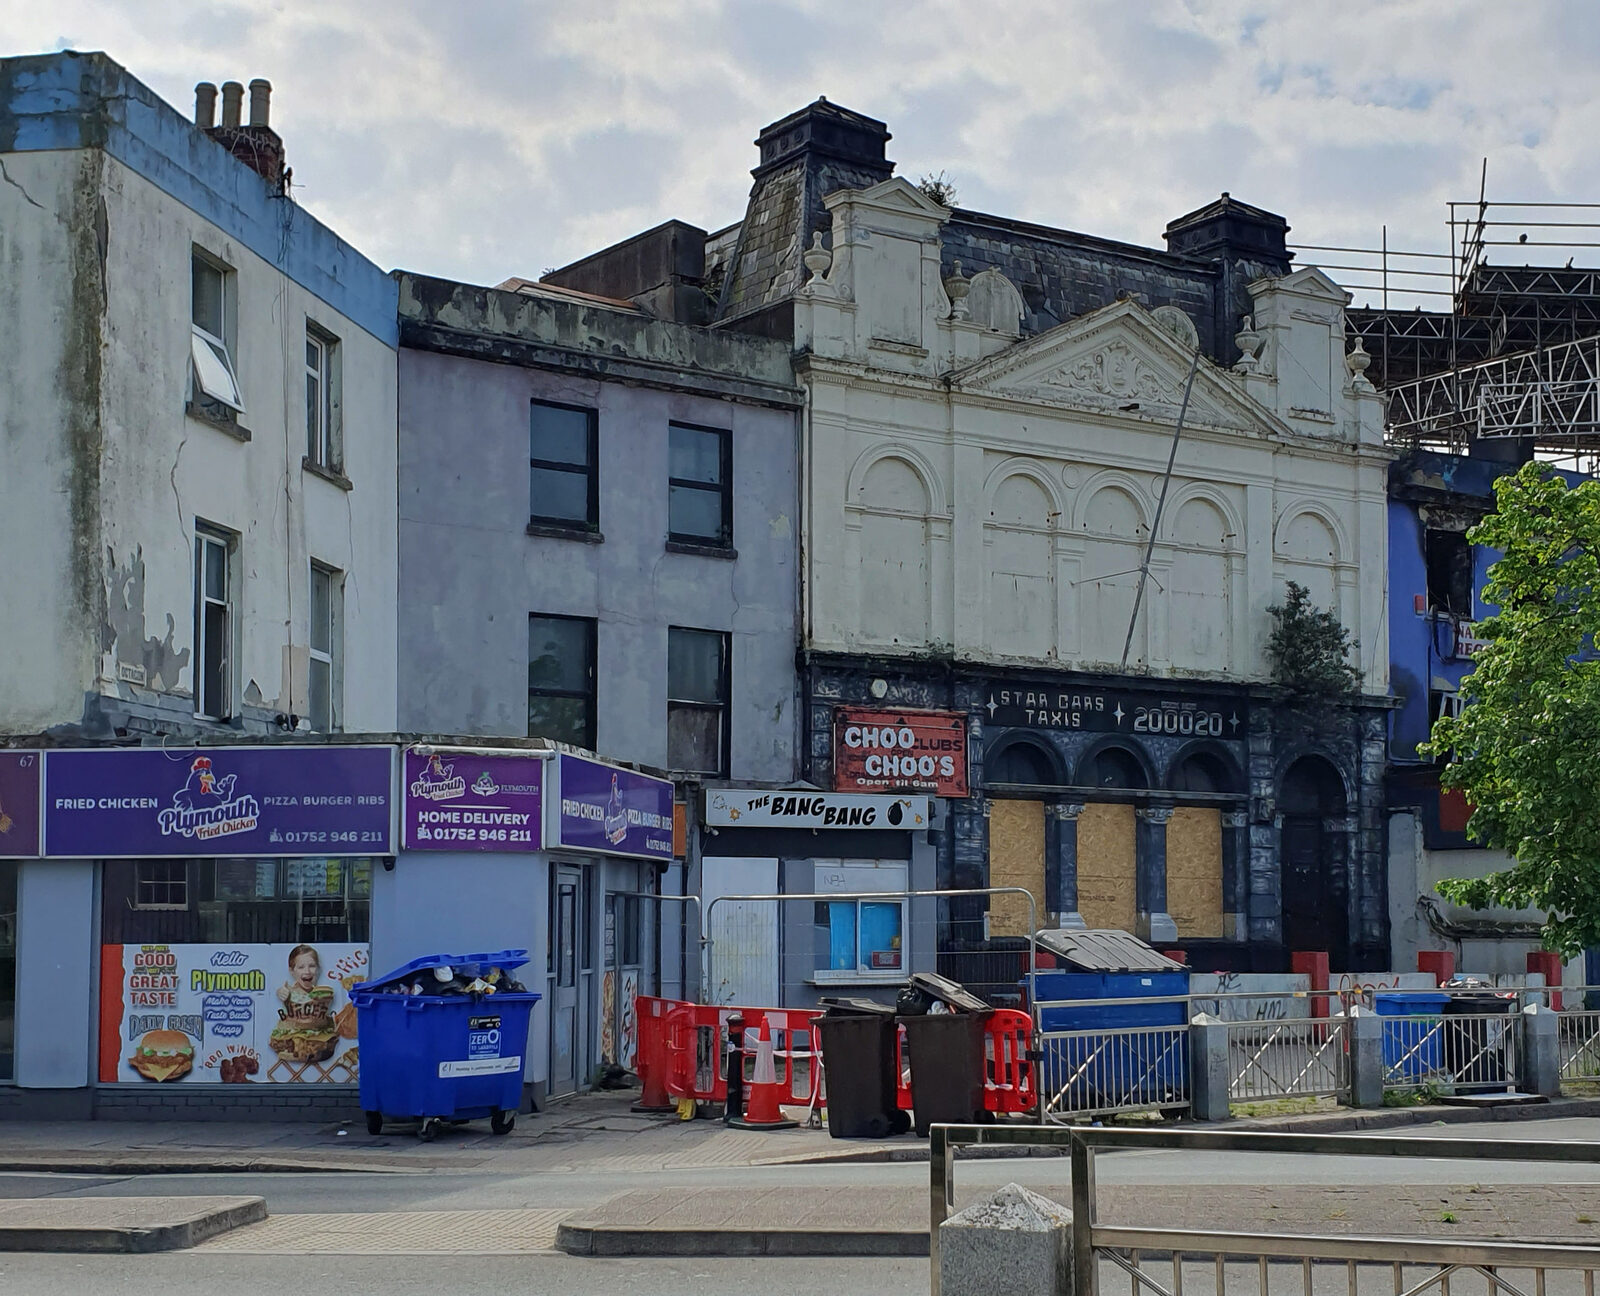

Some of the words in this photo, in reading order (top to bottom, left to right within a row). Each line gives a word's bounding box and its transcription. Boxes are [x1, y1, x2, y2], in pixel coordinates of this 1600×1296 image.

[1000, 690, 1049, 708] STAR
[1058, 694, 1104, 712] CARS
[1025, 709, 1081, 727] TAXIS
[1133, 706, 1223, 737] 200020
[844, 726, 915, 749] CHOO
[20, 755, 34, 768] 67
[865, 754, 955, 777] CHOO'S
[412, 777, 466, 798] Plymouth
[856, 777, 889, 787] Open
[912, 779, 939, 788] 6am
[55, 798, 96, 810] FRIED
[98, 797, 159, 809] CHICKEN
[263, 796, 298, 806] PIZZA
[303, 796, 352, 806] BURGER
[357, 795, 385, 805] RIBS
[158, 796, 259, 836] Plymouth
[418, 811, 460, 823] HOME
[463, 812, 530, 825] DELIVERY
[562, 799, 580, 817] FRIED
[580, 803, 605, 821] CHICKEN
[747, 794, 770, 812] THE
[770, 796, 826, 816] BANG
[823, 806, 877, 826] BANG
[198, 824, 220, 838] Fried
[222, 818, 256, 834] Chicken
[433, 828, 476, 840] 01752
[478, 829, 507, 841] 946
[509, 830, 532, 842] 211
[285, 831, 327, 843] 01752
[329, 831, 358, 842] 946
[360, 831, 383, 842] 211
[133, 952, 176, 967] GOOD
[210, 951, 249, 967] Hello
[129, 975, 179, 988] GREAT
[190, 969, 266, 992] Plymouth
[129, 991, 176, 1005] TASTE
[212, 1023, 243, 1037] Happy
[471, 1030, 499, 1045] ZERO
[204, 1050, 223, 1069] BBQ
